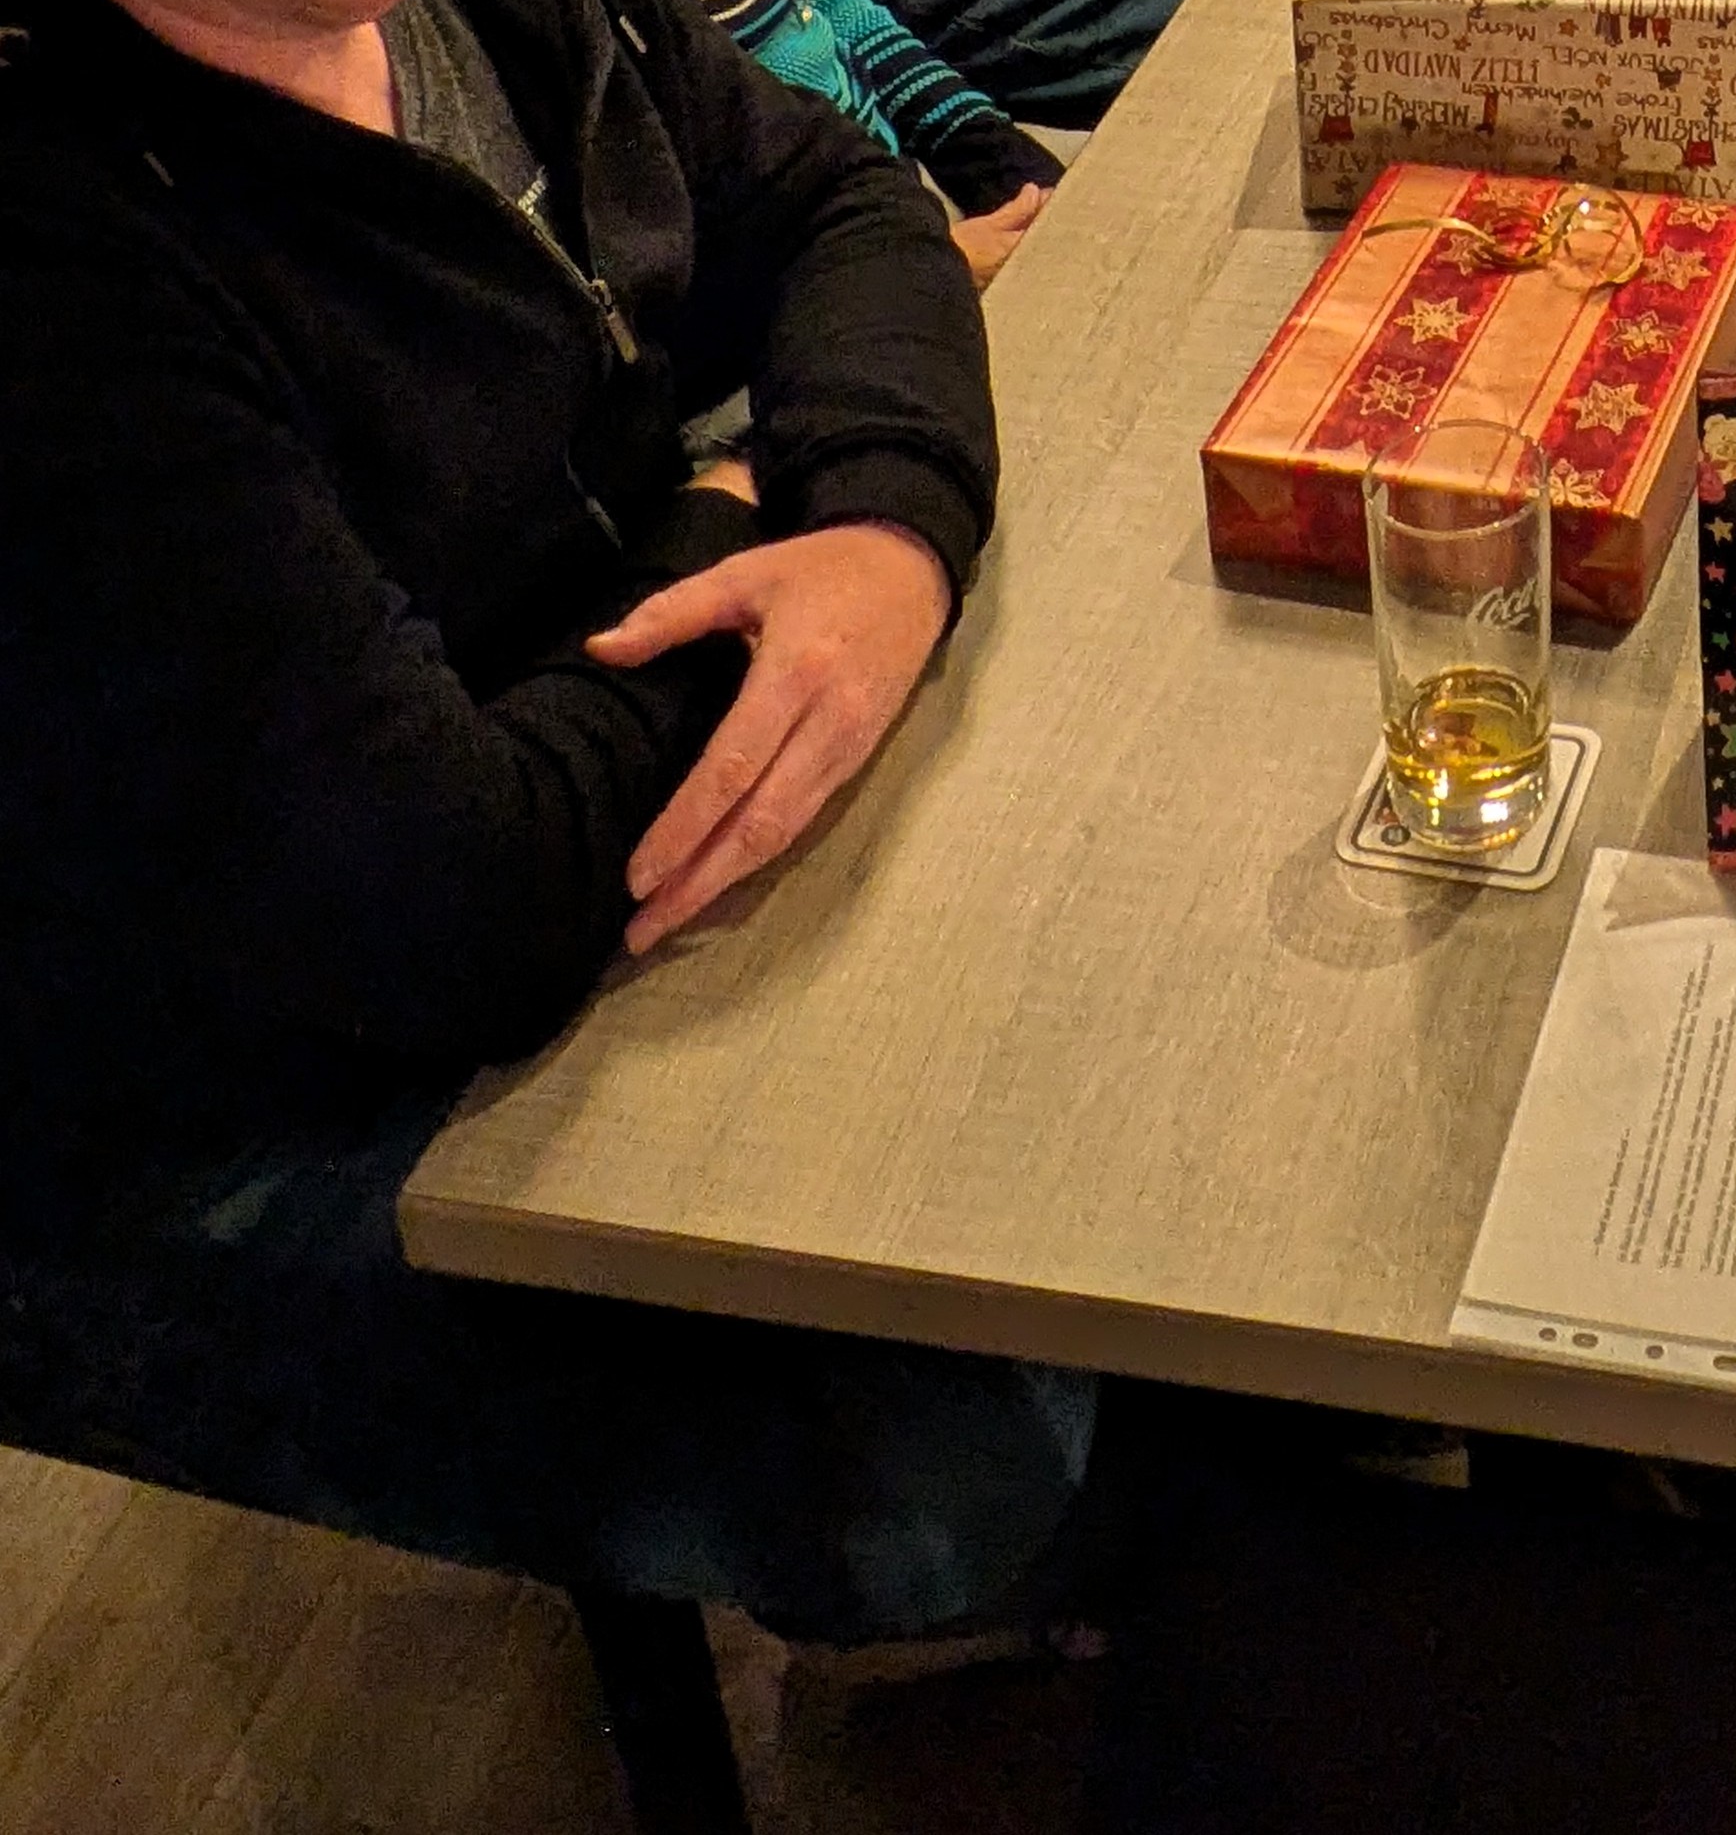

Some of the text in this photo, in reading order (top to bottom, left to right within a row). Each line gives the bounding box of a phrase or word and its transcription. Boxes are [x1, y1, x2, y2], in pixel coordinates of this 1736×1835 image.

[1328, 7, 1537, 43] Merry Christmas
[1363, 49, 1539, 85] FELIZ NAVIDAD
[1382, 90, 1471, 129] MERRY
[1461, 82, 1682, 118] Frohe Weihnachten
